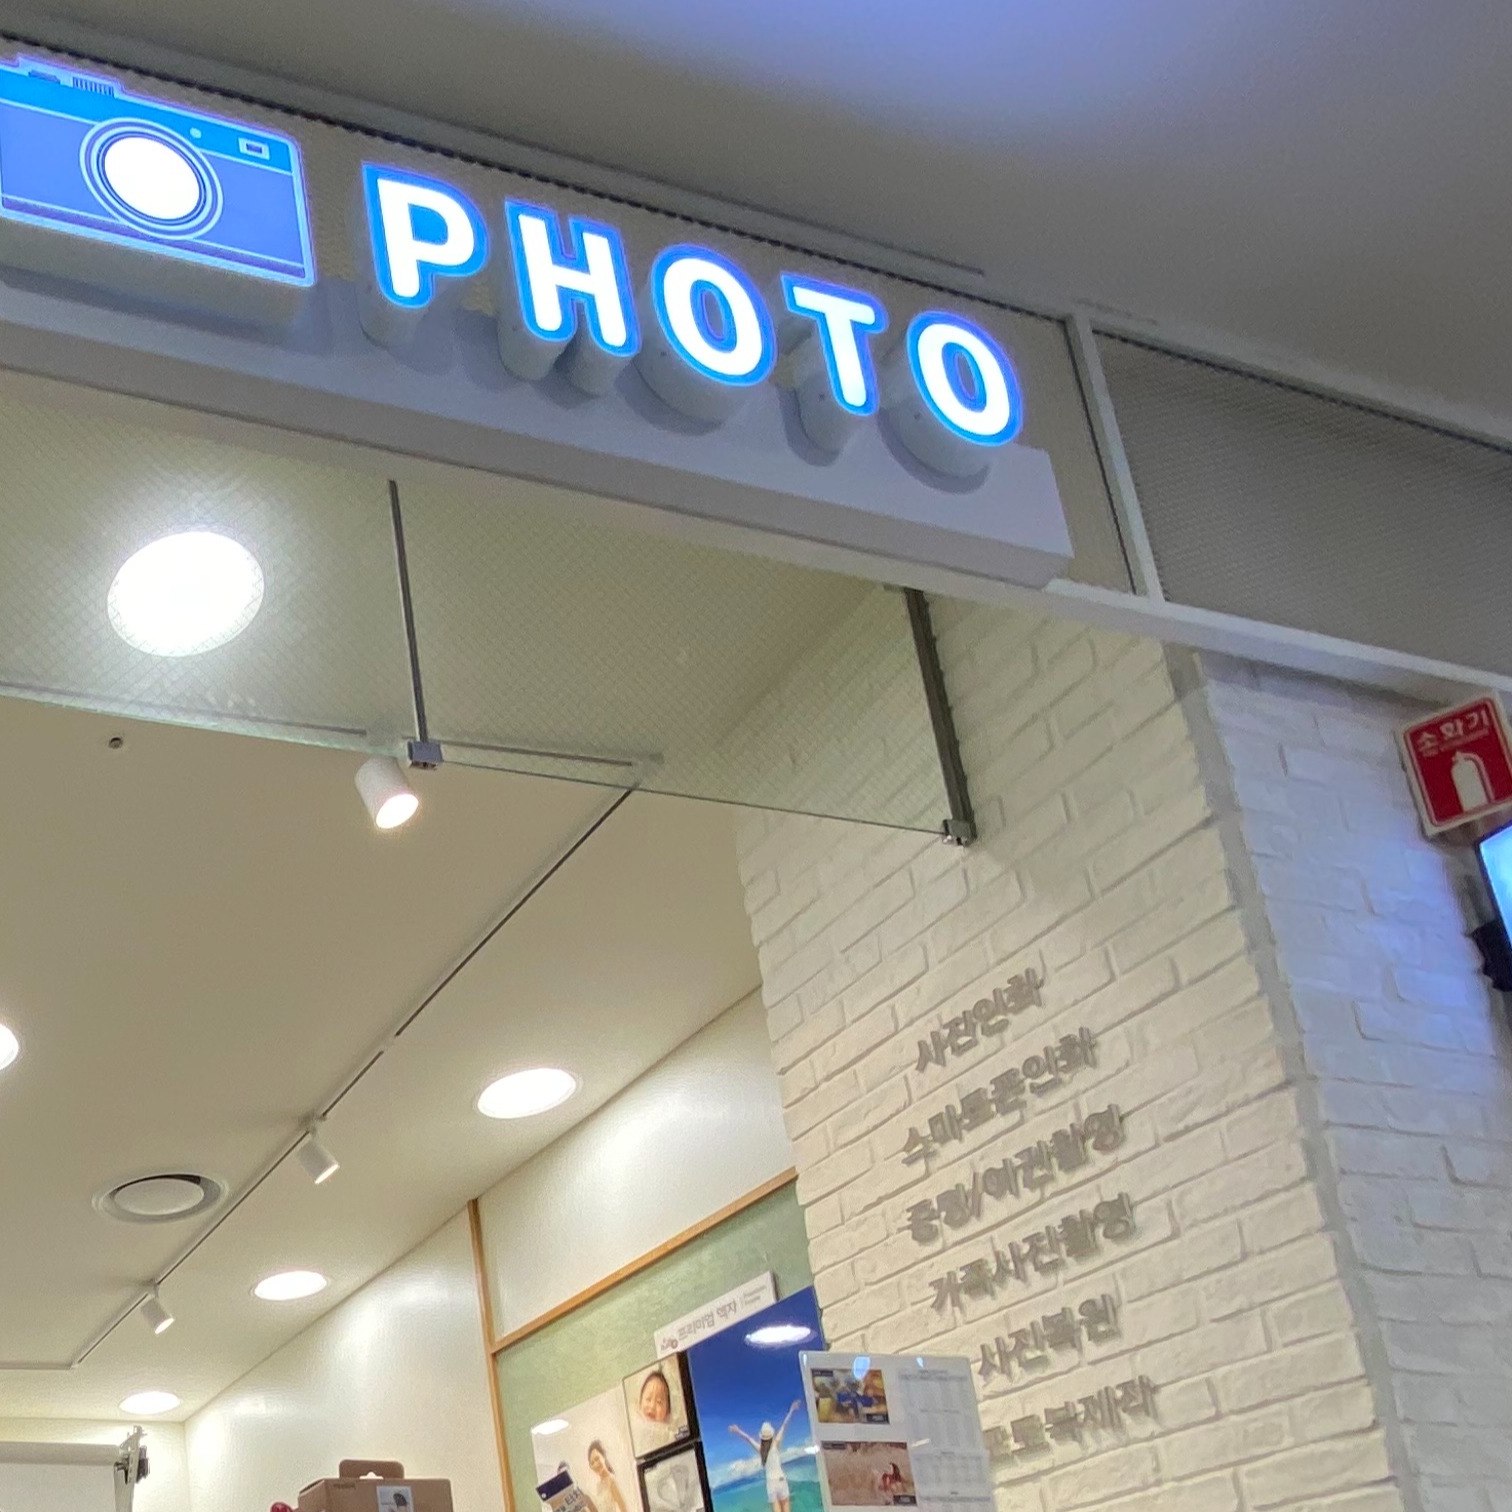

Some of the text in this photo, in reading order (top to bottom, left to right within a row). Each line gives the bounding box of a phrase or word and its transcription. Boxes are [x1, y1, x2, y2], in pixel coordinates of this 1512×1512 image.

[360, 160, 1023, 448] PHOTO
[1417, 708, 1491, 758] 소화기
[915, 967, 1044, 1073] 사진인화
[901, 1026, 1097, 1166] 스마트폰인화
[928, 1192, 1136, 1313] 가족사진촬영
[678, 1311, 715, 1341] 프리미엄
[977, 1293, 1122, 1382] 사진복원
